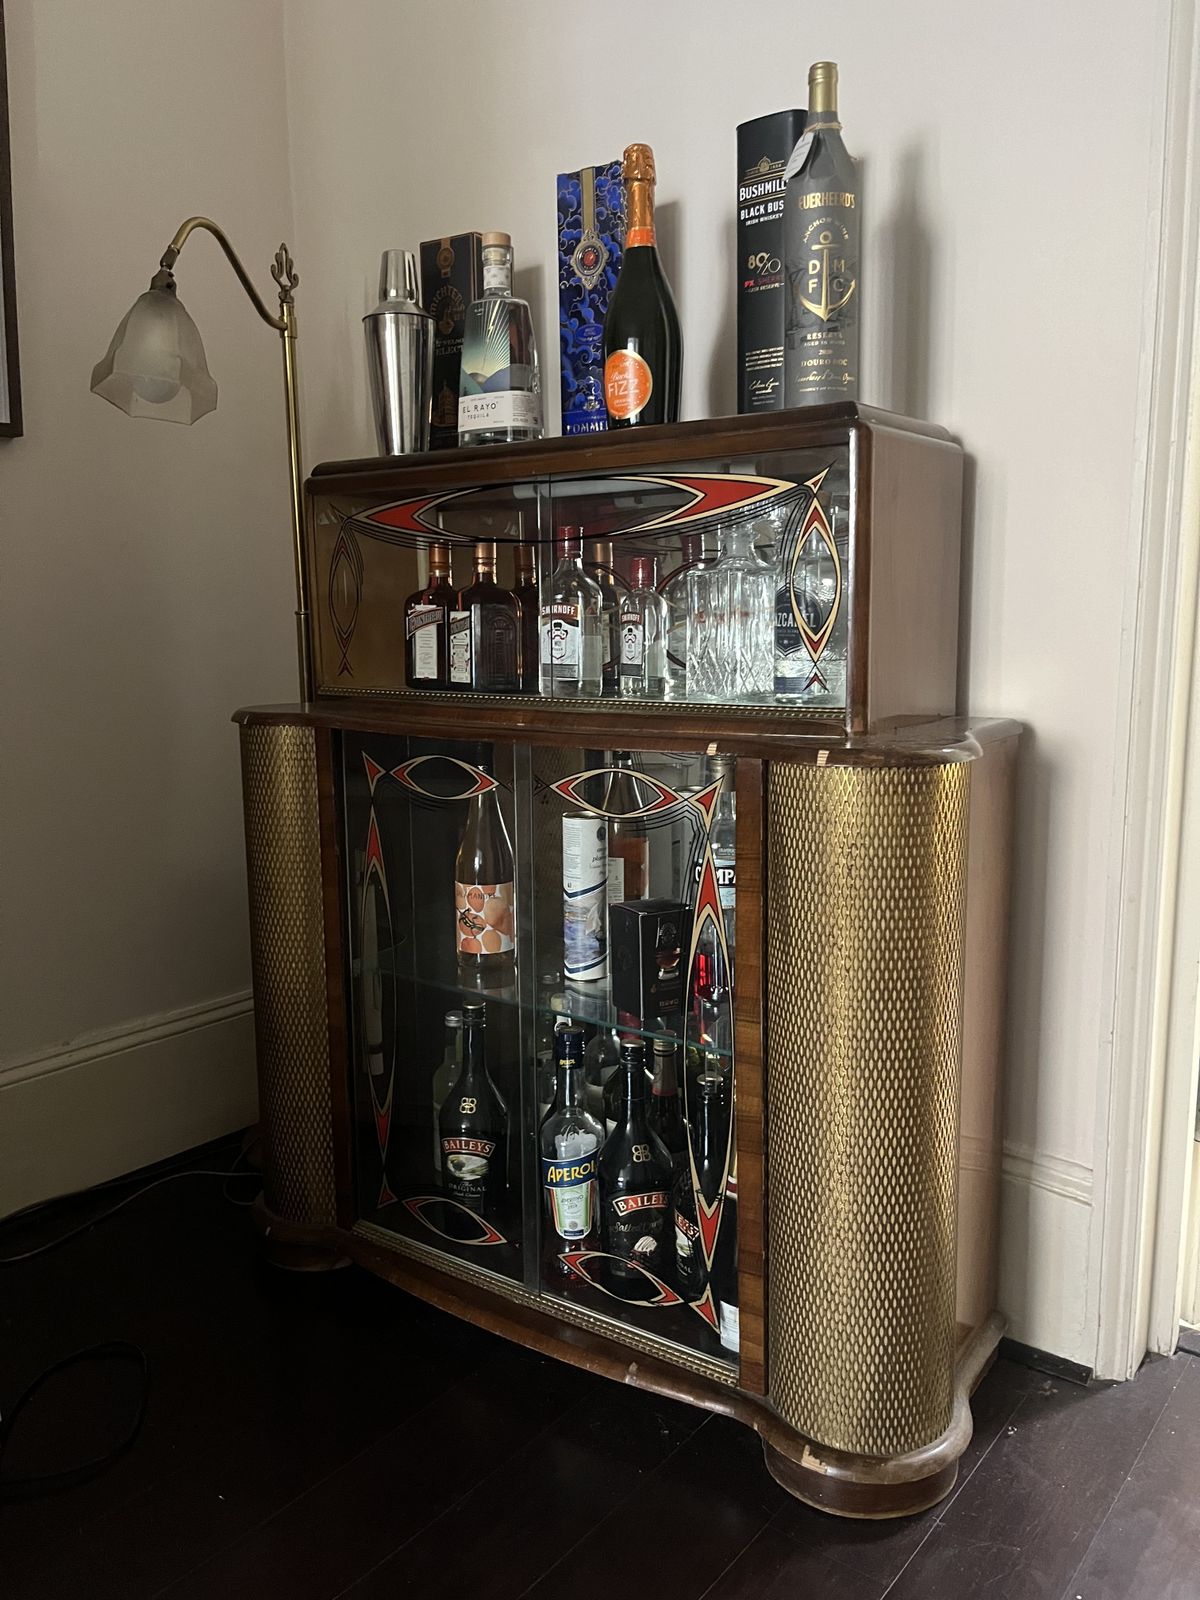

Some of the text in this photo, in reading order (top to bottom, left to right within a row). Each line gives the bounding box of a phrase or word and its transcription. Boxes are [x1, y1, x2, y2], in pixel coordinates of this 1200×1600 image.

[739, 178, 789, 202] BUSHMILL
[740, 200, 785, 220] BLACK BUS
[760, 212, 784, 223] WHISKEY
[809, 259, 821, 274] D
[808, 278, 819, 293] F
[436, 345, 464, 356] ELECT
[607, 378, 640, 398] FIZZ
[462, 402, 497, 414] EL RAYO
[566, 419, 609, 433] POMME
[541, 604, 576, 617] SMIRNOFF
[694, 865, 737, 885] CMP
[443, 1139, 492, 1154] BAILEYS
[547, 1161, 597, 1184] APEROL
[449, 1182, 488, 1192] ORIGINAL
